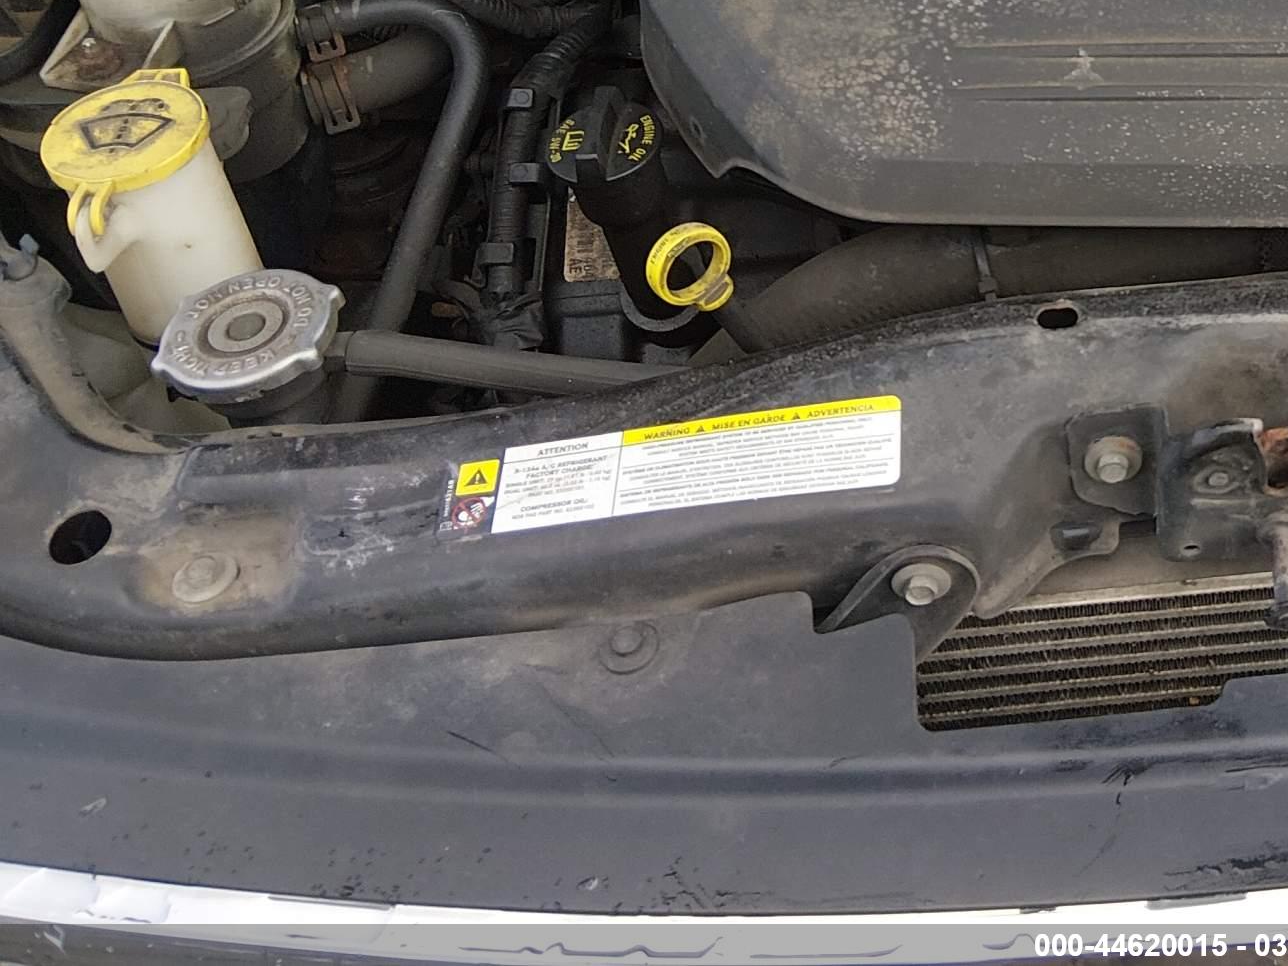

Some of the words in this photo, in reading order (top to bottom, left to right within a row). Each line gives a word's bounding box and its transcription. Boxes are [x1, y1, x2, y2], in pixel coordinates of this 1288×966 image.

[640, 114, 656, 145] ENGINE
[627, 147, 647, 162] OIL
[228, 276, 281, 294] OPEN
[285, 281, 313, 307] NOT
[187, 291, 224, 319] HOT
[293, 307, 312, 328] DO
[213, 351, 277, 377] KEEP
[644, 425, 691, 441] WARNING
[711, 420, 736, 431] MISE
[737, 418, 751, 427] EN
[753, 414, 786, 425] GARDE
[807, 403, 875, 419] ADVERTENCIA
[537, 441, 589, 457] ATTENTION
